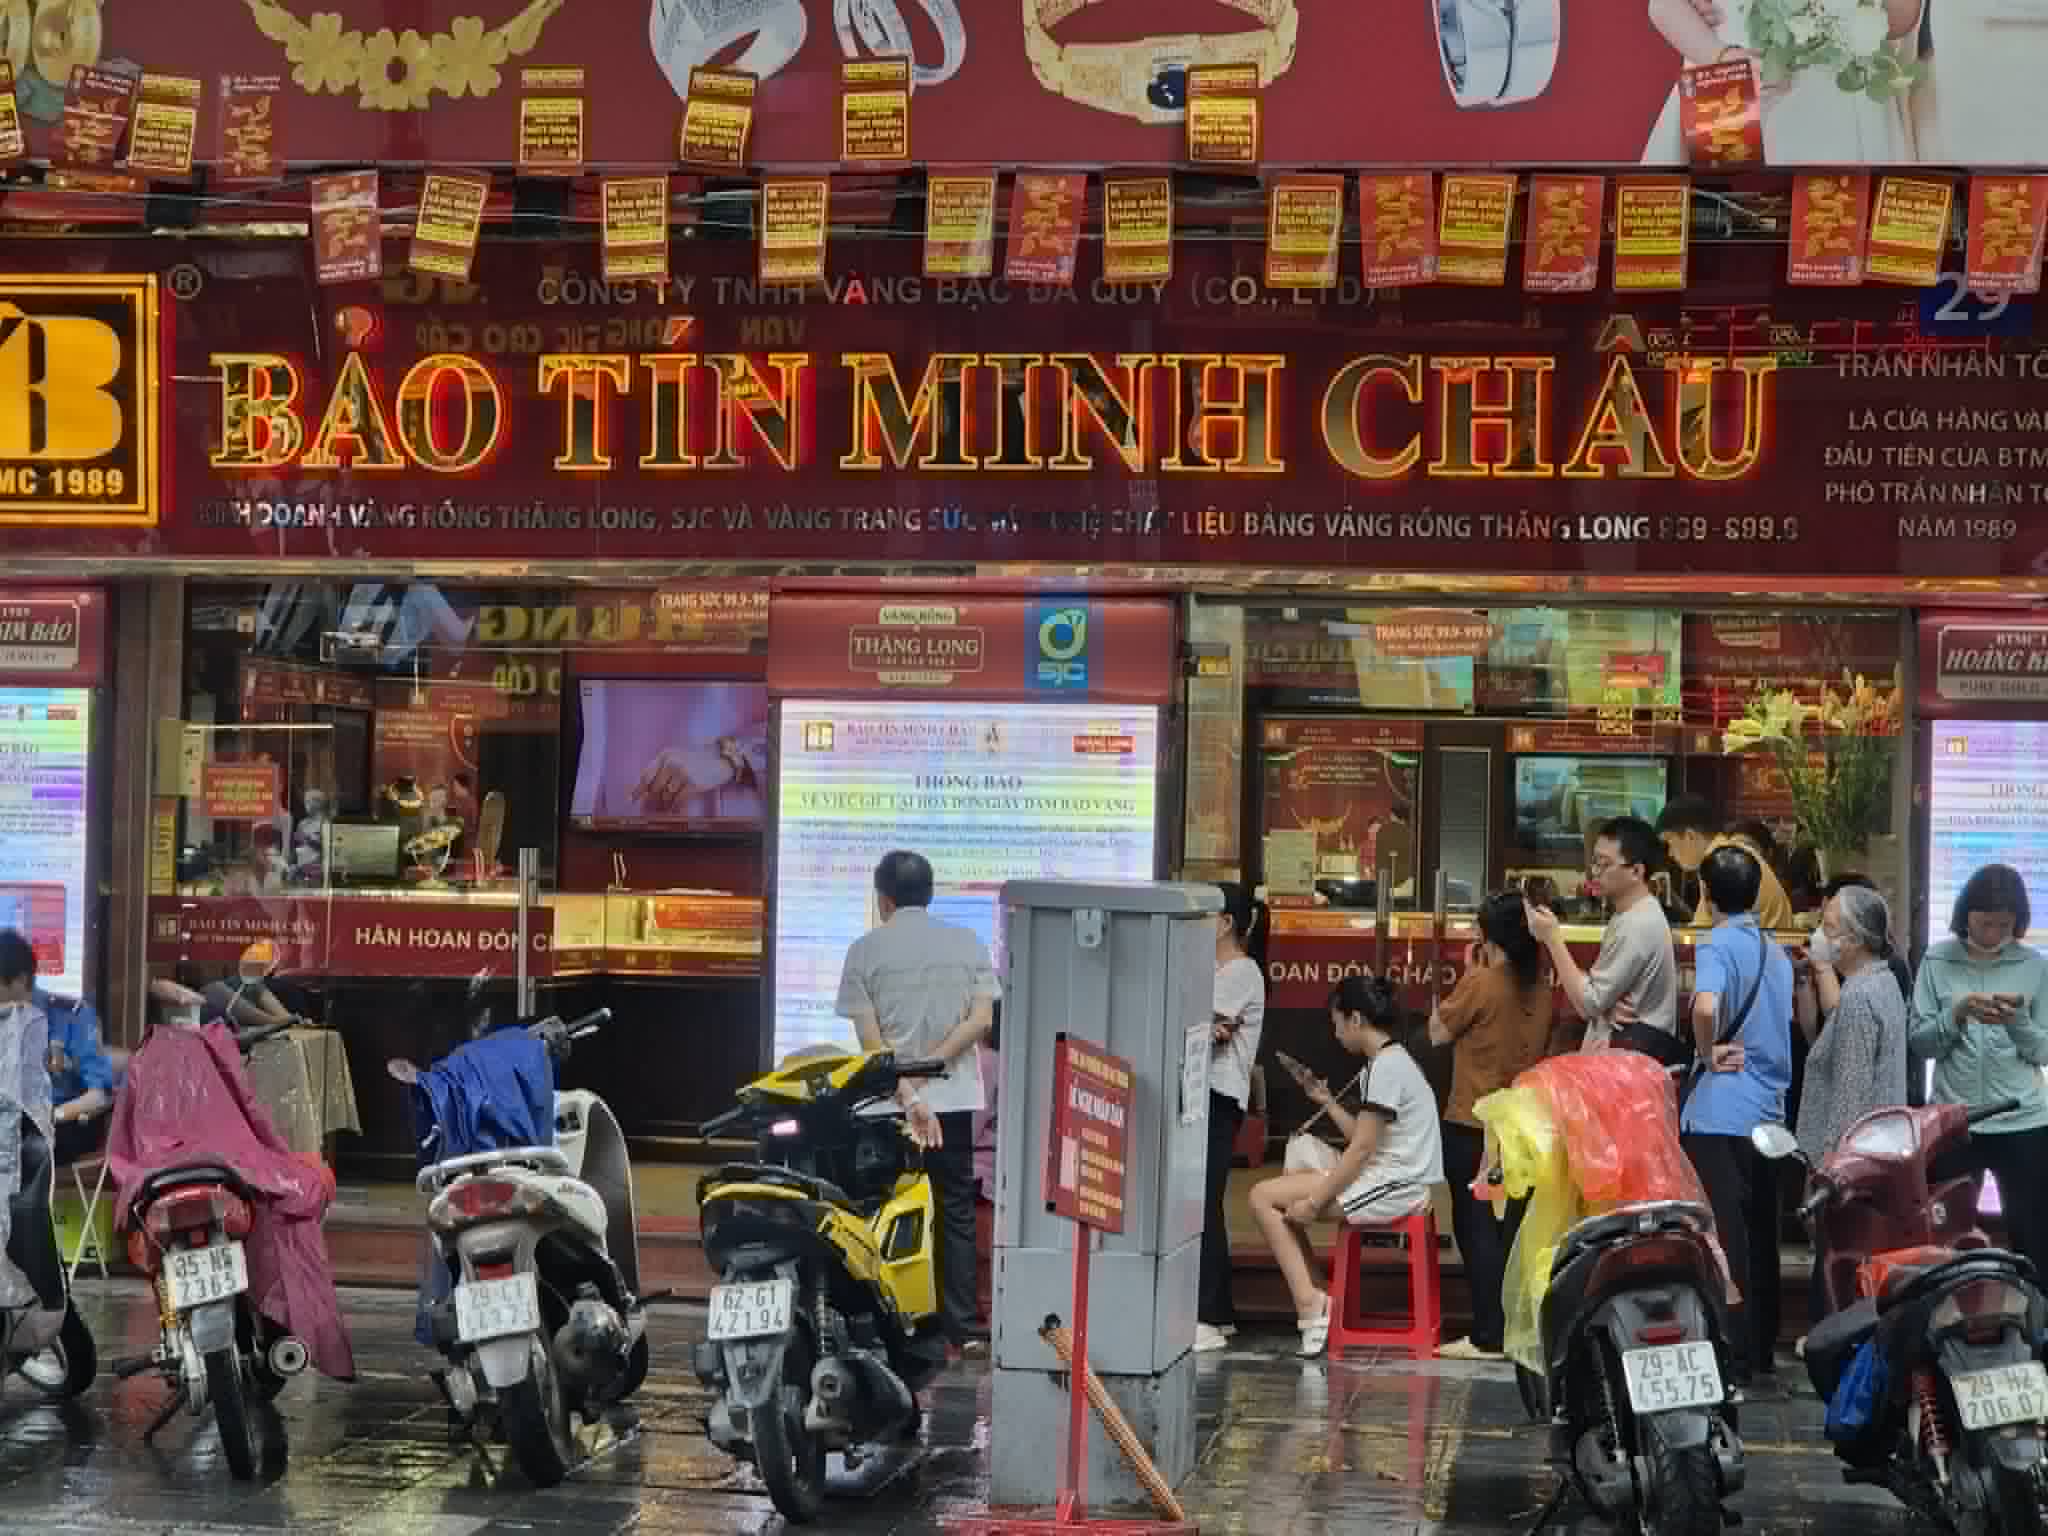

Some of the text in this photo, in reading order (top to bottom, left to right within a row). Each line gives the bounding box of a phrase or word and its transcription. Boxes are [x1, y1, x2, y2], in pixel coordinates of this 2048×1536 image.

[210, 306, 1777, 481] BẢO TÍN MINH CHÂU
[50, 467, 125, 495] 1989
[1578, 514, 1650, 540] LONG
[926, 638, 979, 657] LONG
[408, 928, 471, 950] HOAN
[1268, 961, 1321, 984] OAN
